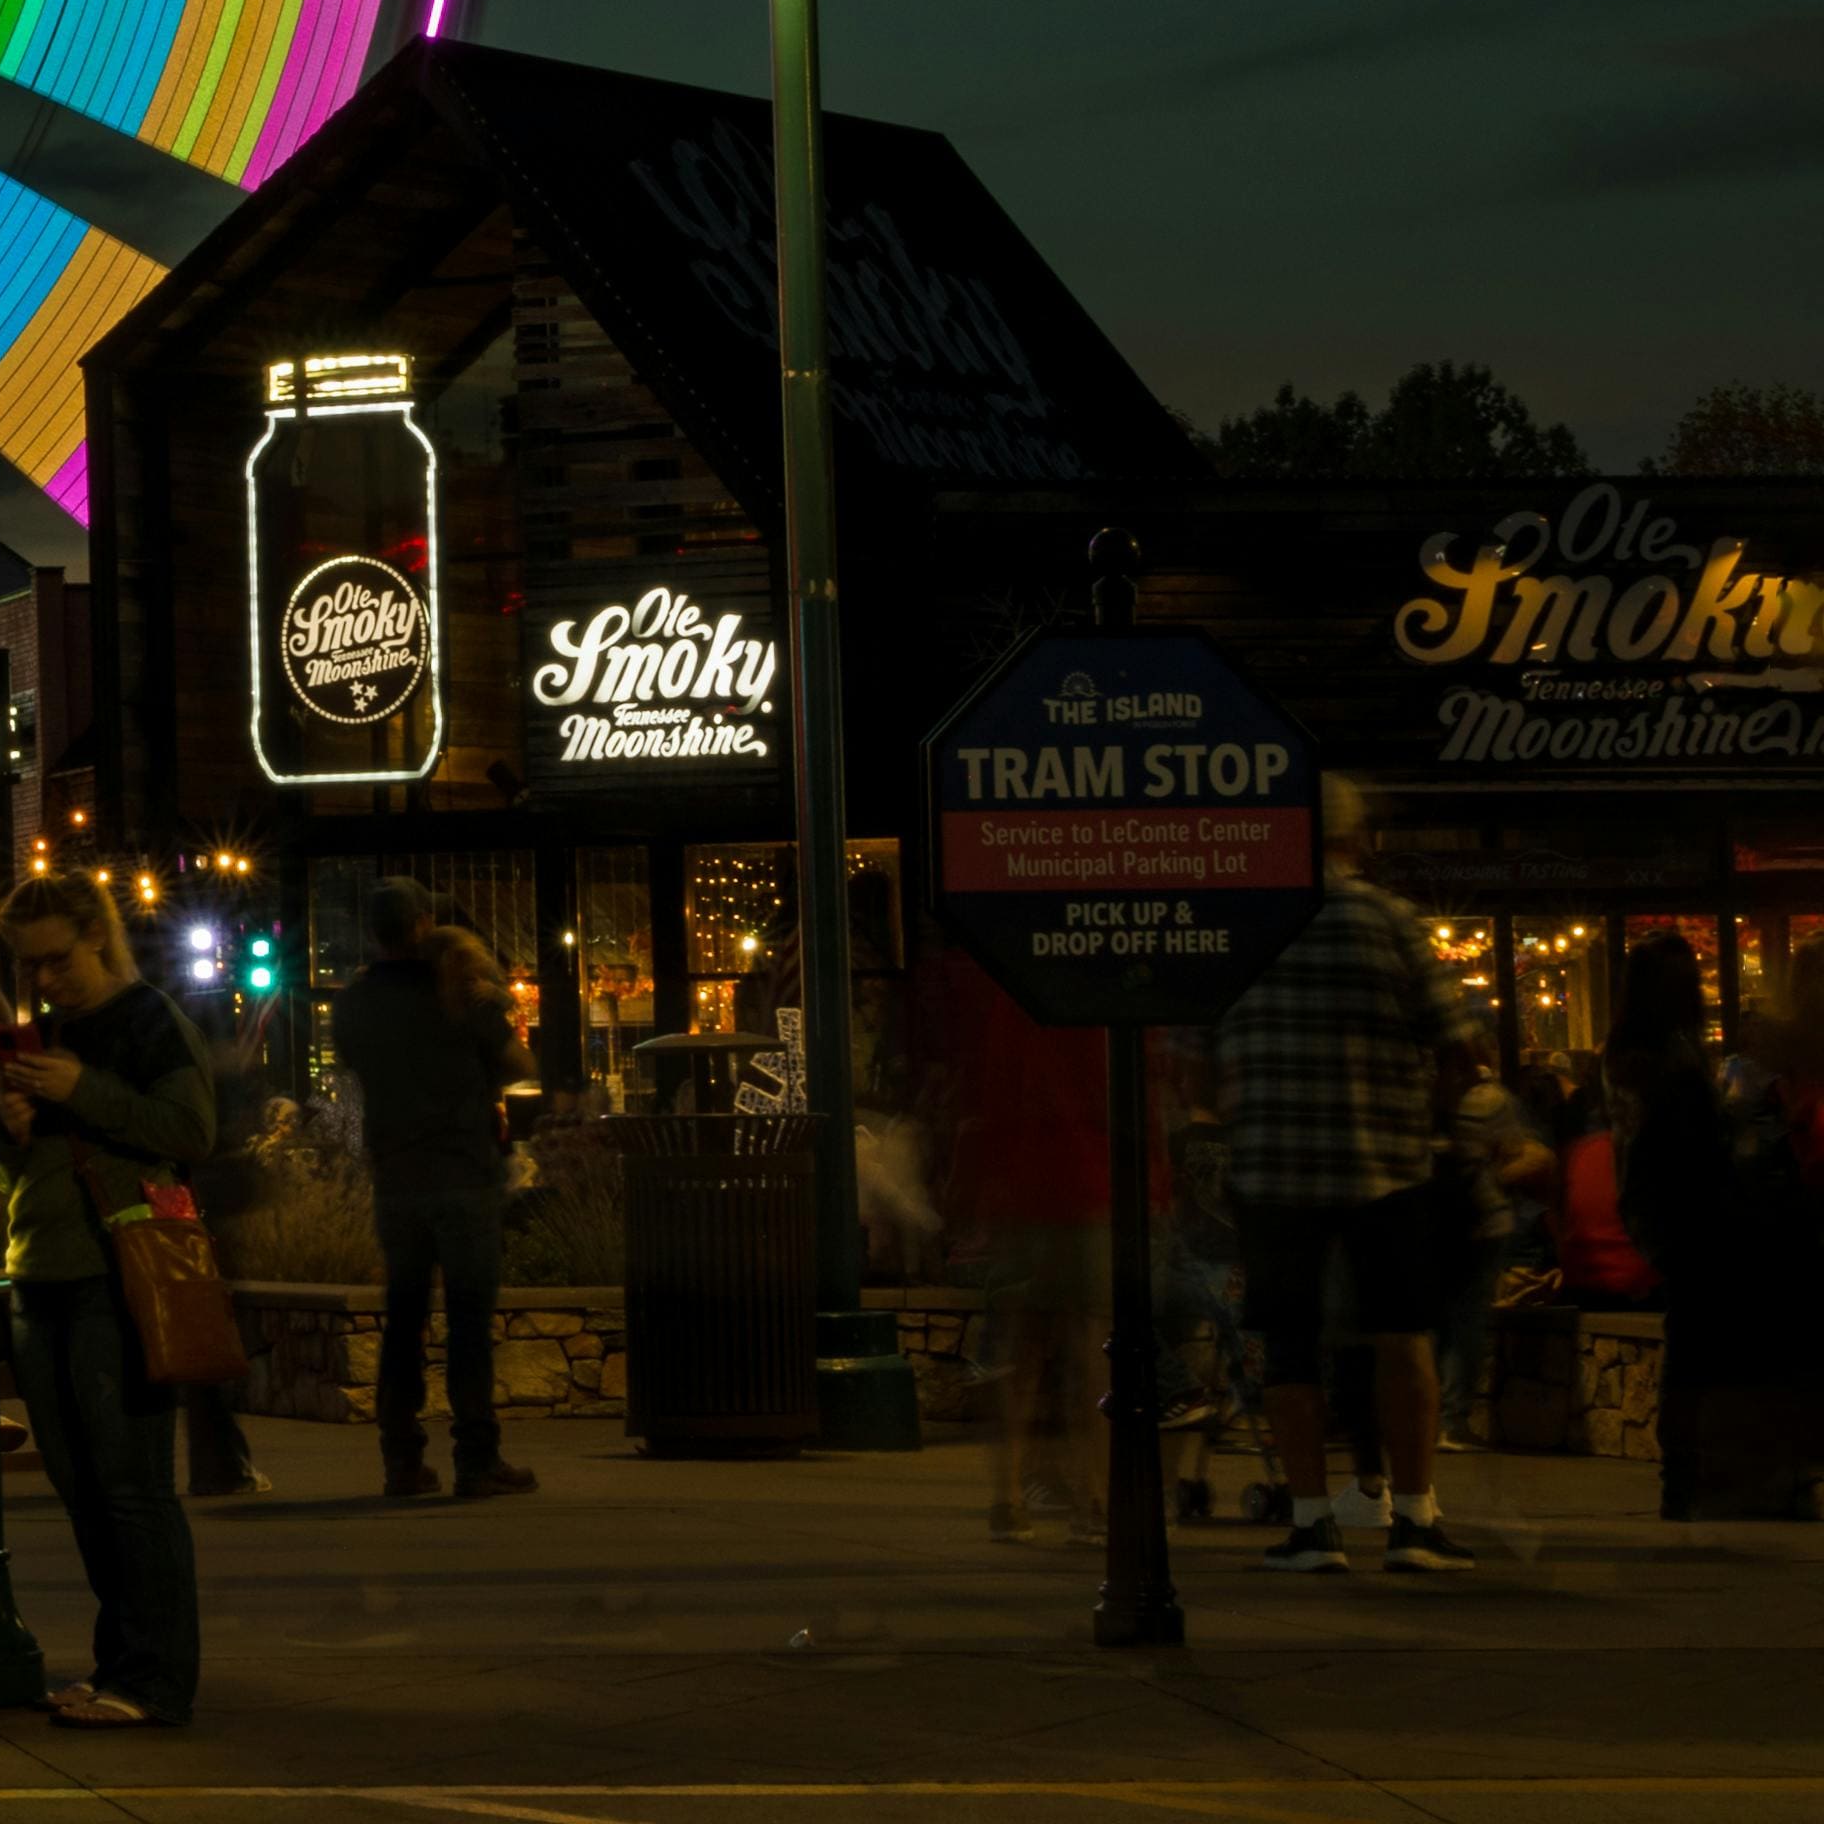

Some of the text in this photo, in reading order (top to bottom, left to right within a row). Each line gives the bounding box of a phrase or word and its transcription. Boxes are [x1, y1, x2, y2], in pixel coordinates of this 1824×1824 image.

[1556, 482, 1703, 569] Ole
[334, 581, 380, 614] Ole
[632, 587, 714, 641] Ole
[289, 590, 419, 657] Smoky
[304, 647, 418, 687] Moonshine
[533, 606, 775, 715] Smoky
[1520, 669, 1665, 703] Tennessee
[613, 703, 691, 726] Tennessee
[1042, 692, 1203, 725] THE ISLAND
[559, 713, 768, 762] Moonshine
[957, 742, 1291, 801] TRAM STOP
[980, 817, 1272, 847] Service to LeConte Center
[1007, 849, 1248, 881] Municipal Parking Lot
[1065, 900, 1194, 927] PICK UP &
[1032, 928, 1231, 957] DROP OFF HERE
